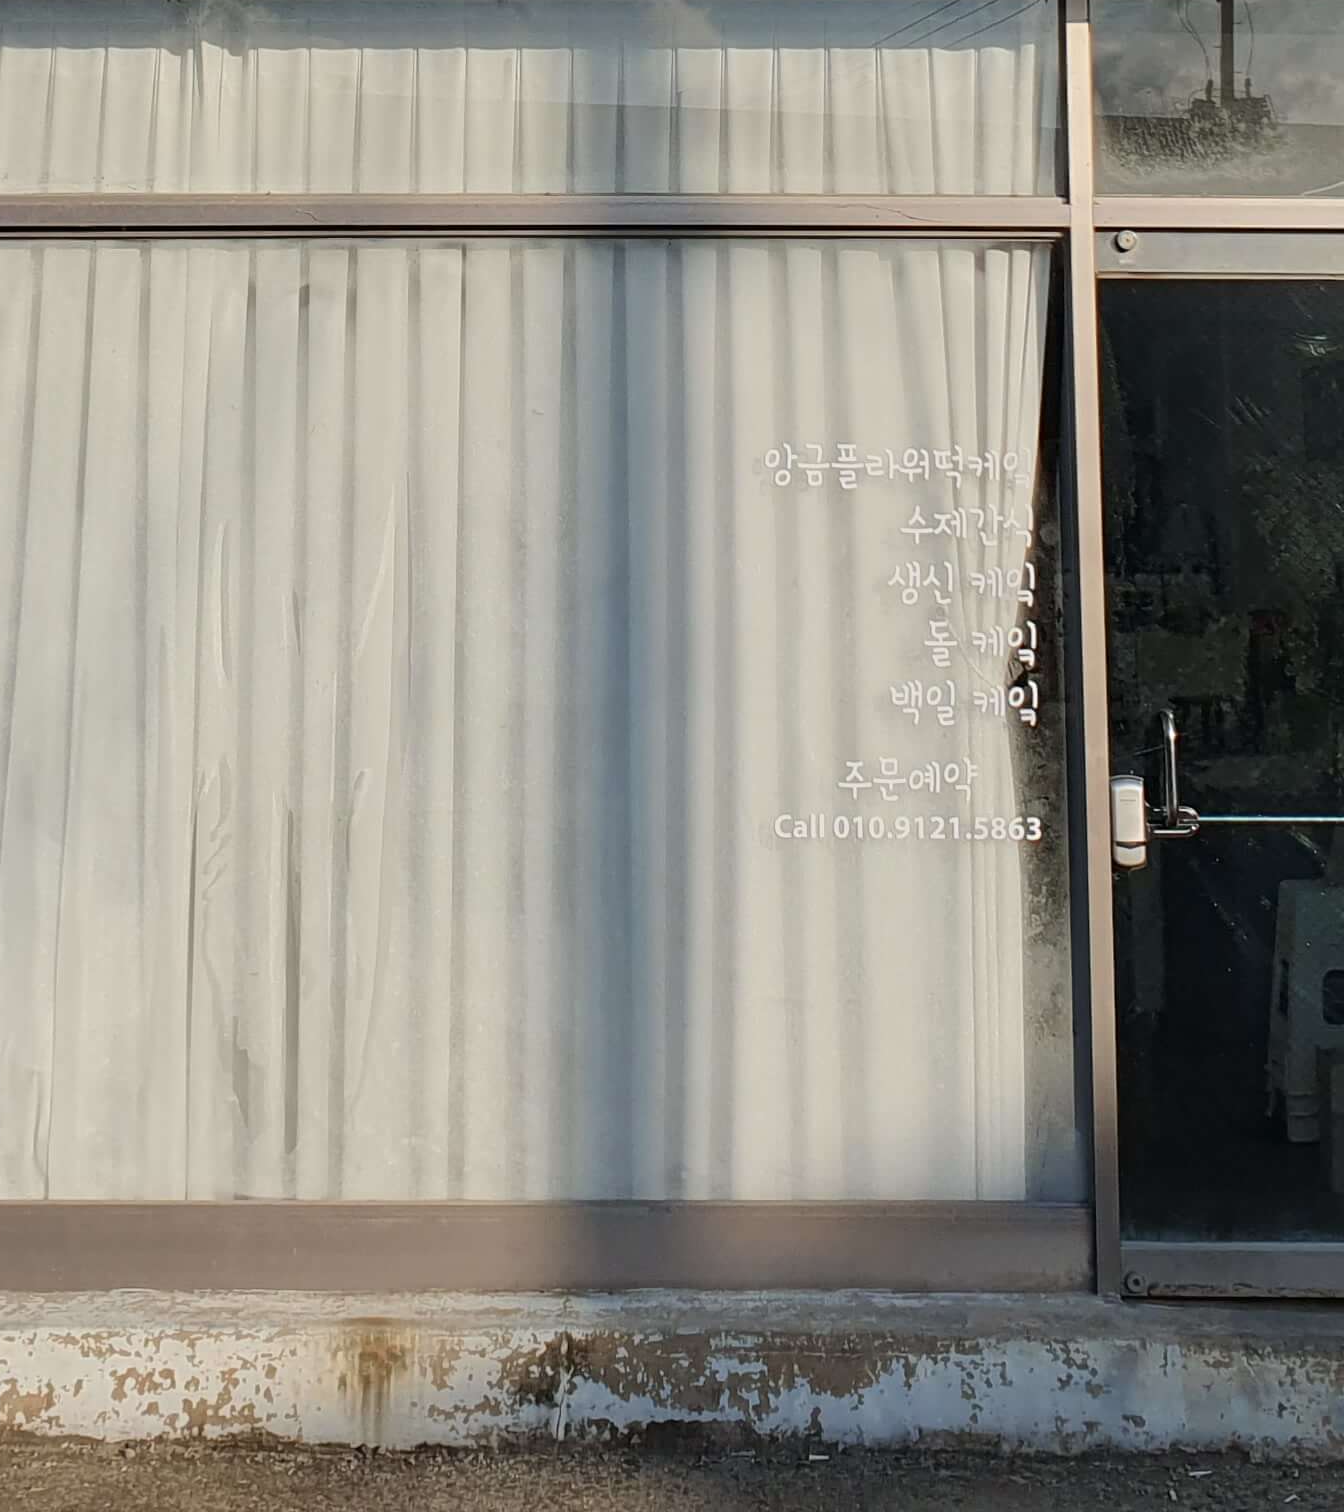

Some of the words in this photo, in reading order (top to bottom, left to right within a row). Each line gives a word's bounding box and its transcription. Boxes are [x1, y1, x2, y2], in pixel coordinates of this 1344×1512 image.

[900, 502, 1034, 548] 수제간식
[887, 560, 953, 605] 생신
[924, 620, 958, 668] 돌
[889, 679, 956, 726] 백일
[839, 757, 978, 802] 주문예약
[774, 814, 825, 840] Call
[833, 816, 1042, 842] 010.9121.5863
